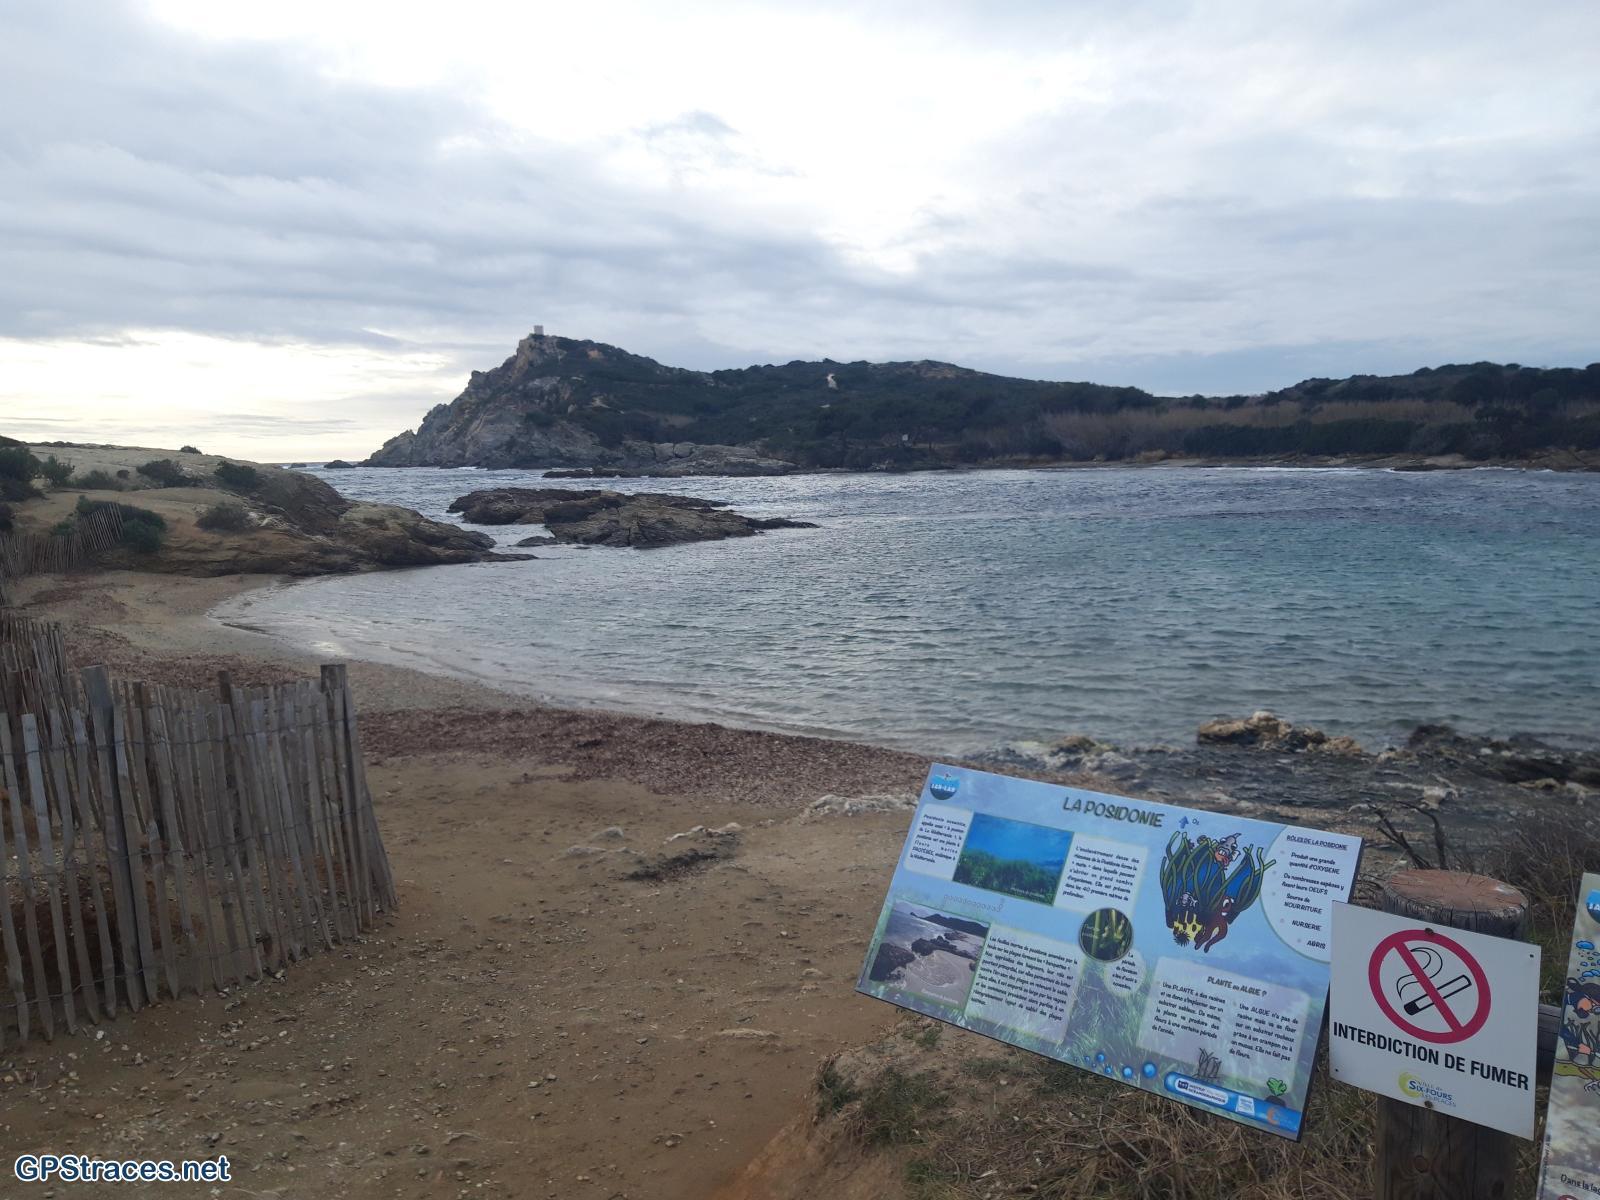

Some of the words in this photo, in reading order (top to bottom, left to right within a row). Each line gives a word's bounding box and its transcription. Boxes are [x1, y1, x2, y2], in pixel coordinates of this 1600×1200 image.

[1062, 797, 1081, 811] LA
[1084, 801, 1163, 827] POSIDONIE
[1284, 901, 1321, 913] NOURRITURE
[1292, 920, 1321, 930] NURSERIE
[1306, 940, 1325, 949] ABRIS
[1172, 984, 1193, 994] PLANTE
[1207, 976, 1232, 988] PLANTE
[1240, 985, 1260, 995] ALGUE
[1250, 1006, 1270, 1016] ALGUE
[1334, 1022, 1438, 1065] INTERDICTION
[1445, 1054, 1465, 1072] DE
[1471, 1060, 1529, 1090] FUMER
[1409, 1081, 1452, 1100] SIX-FOURS
[1561, 1174, 1581, 1187] Dans
[1583, 1180, 1589, 1190] la
